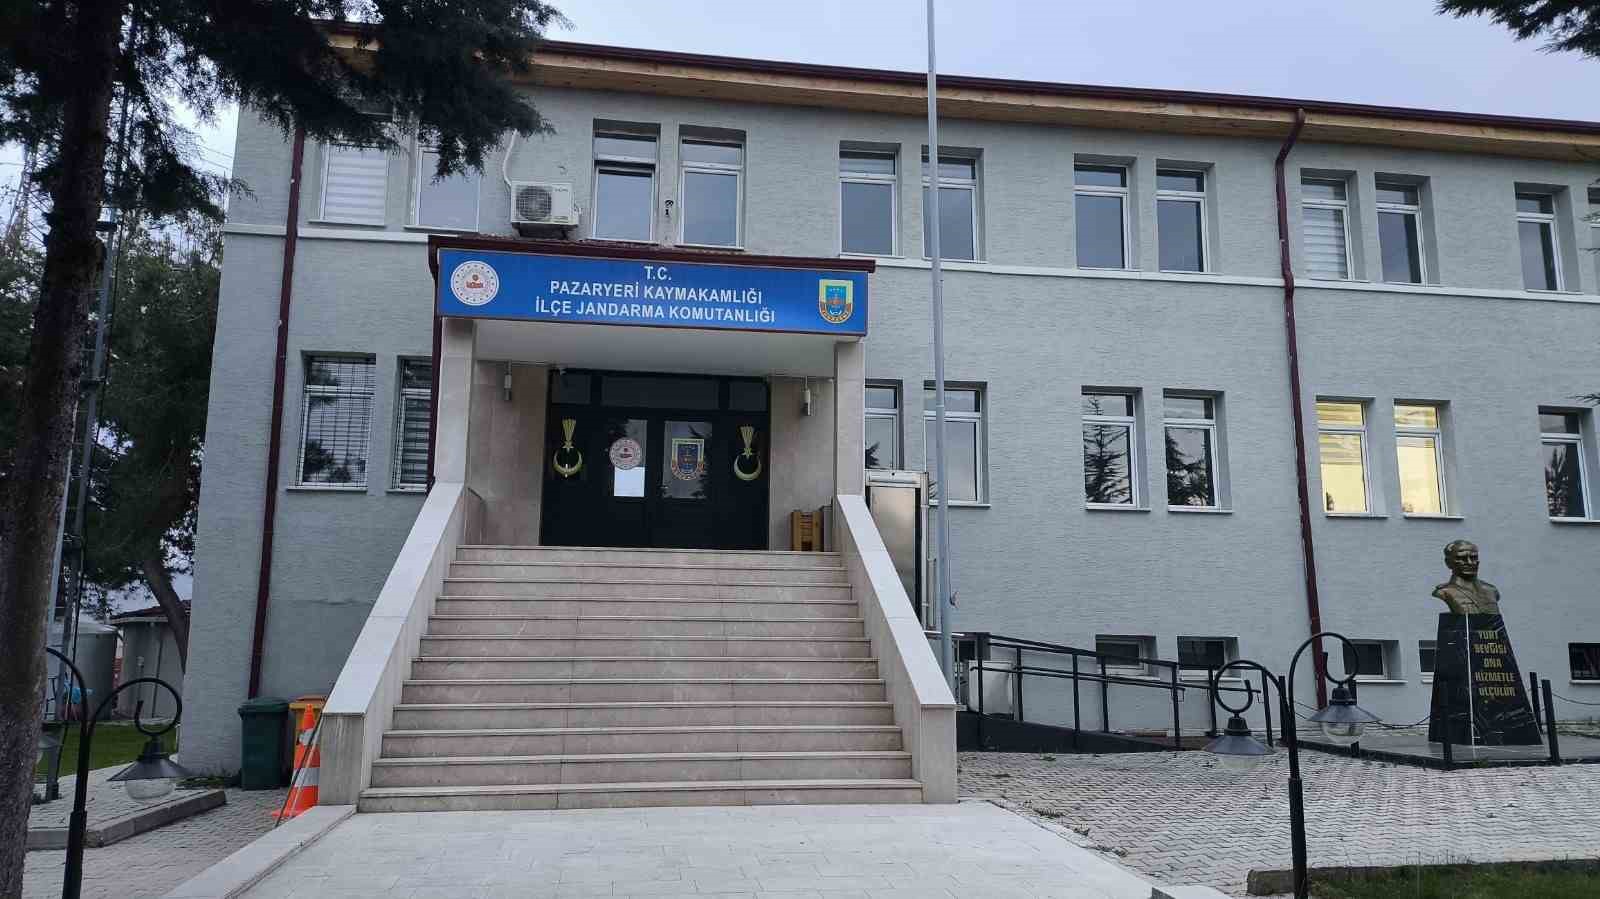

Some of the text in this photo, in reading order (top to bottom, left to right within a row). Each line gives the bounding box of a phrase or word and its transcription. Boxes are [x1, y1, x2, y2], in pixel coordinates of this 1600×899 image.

[643, 265, 672, 280] T.C.
[550, 280, 762, 304] PAZARYERİ KAYMAKAMLIĞI
[535, 295, 775, 323] İLÇE JANDARMA KOMUTANLIĞI
